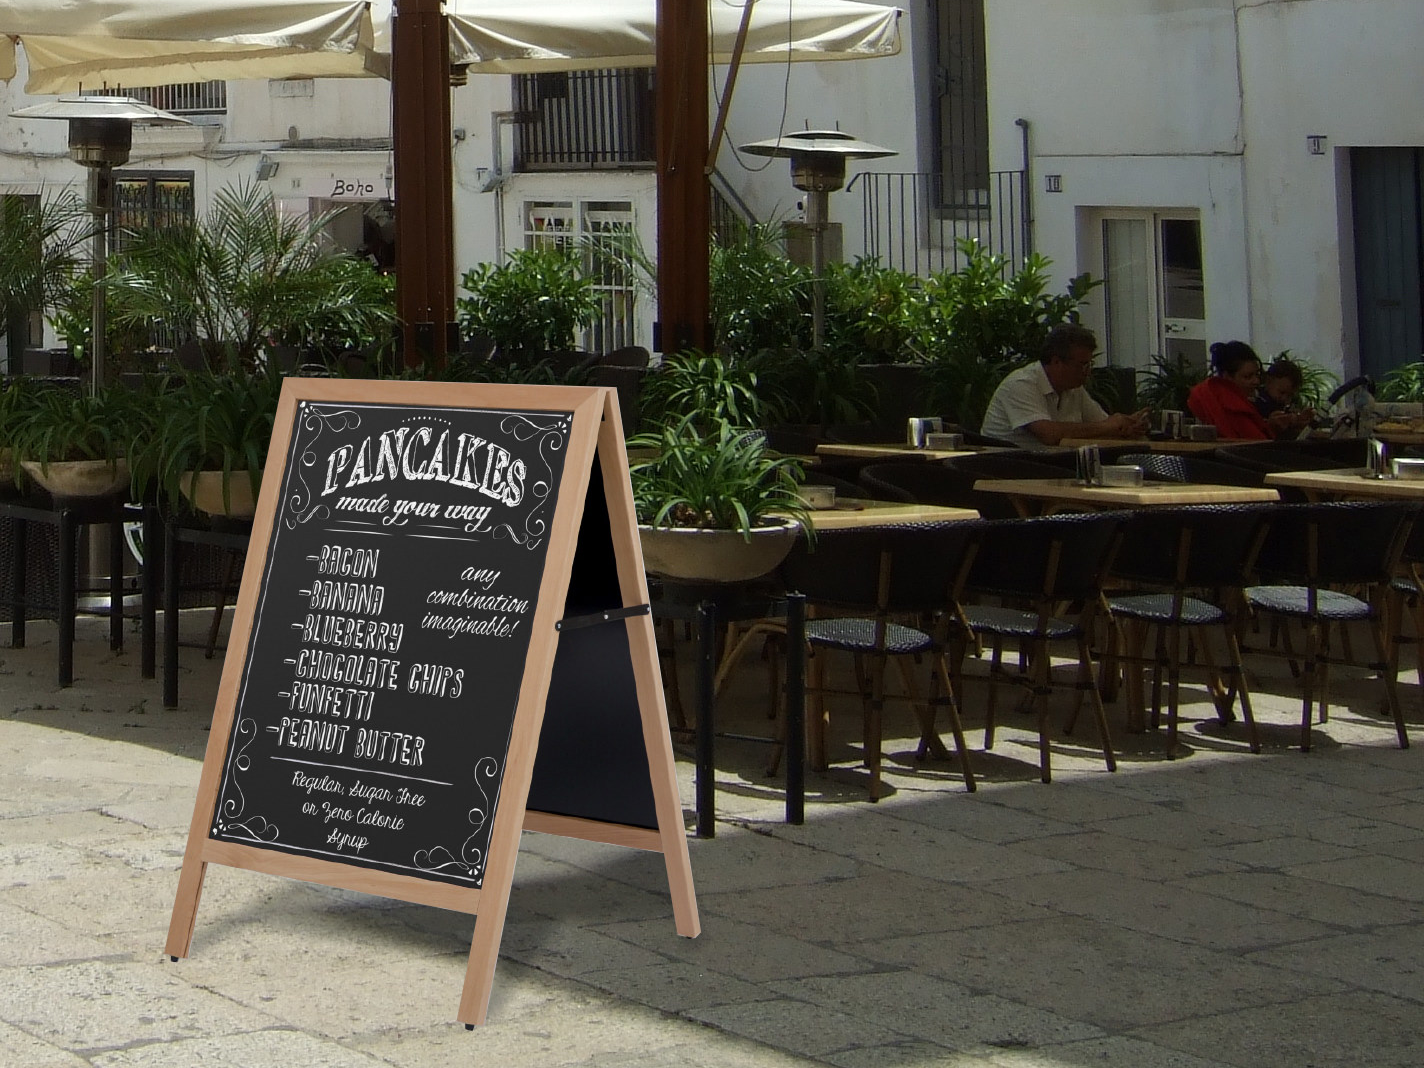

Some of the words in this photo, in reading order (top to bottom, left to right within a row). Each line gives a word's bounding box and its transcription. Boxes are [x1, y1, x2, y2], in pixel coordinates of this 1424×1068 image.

[331, 179, 374, 197] Boho
[321, 426, 527, 507] PANCAKES
[335, 493, 389, 513] made
[382, 499, 441, 526] your
[444, 505, 492, 532] way
[461, 566, 501, 591] any
[426, 588, 529, 614] combination
[421, 612, 521, 639] imaginable!
[407, 663, 465, 698] CHIPS
[353, 727, 426, 767] BUTTER
[292, 770, 345, 795] Regular,
[348, 780, 393, 804] Sugar
[395, 787, 426, 807] Free
[302, 801, 319, 816] or
[322, 802, 355, 823] Zero
[356, 807, 405, 830] Calorie
[326, 827, 370, 852] Syrup
